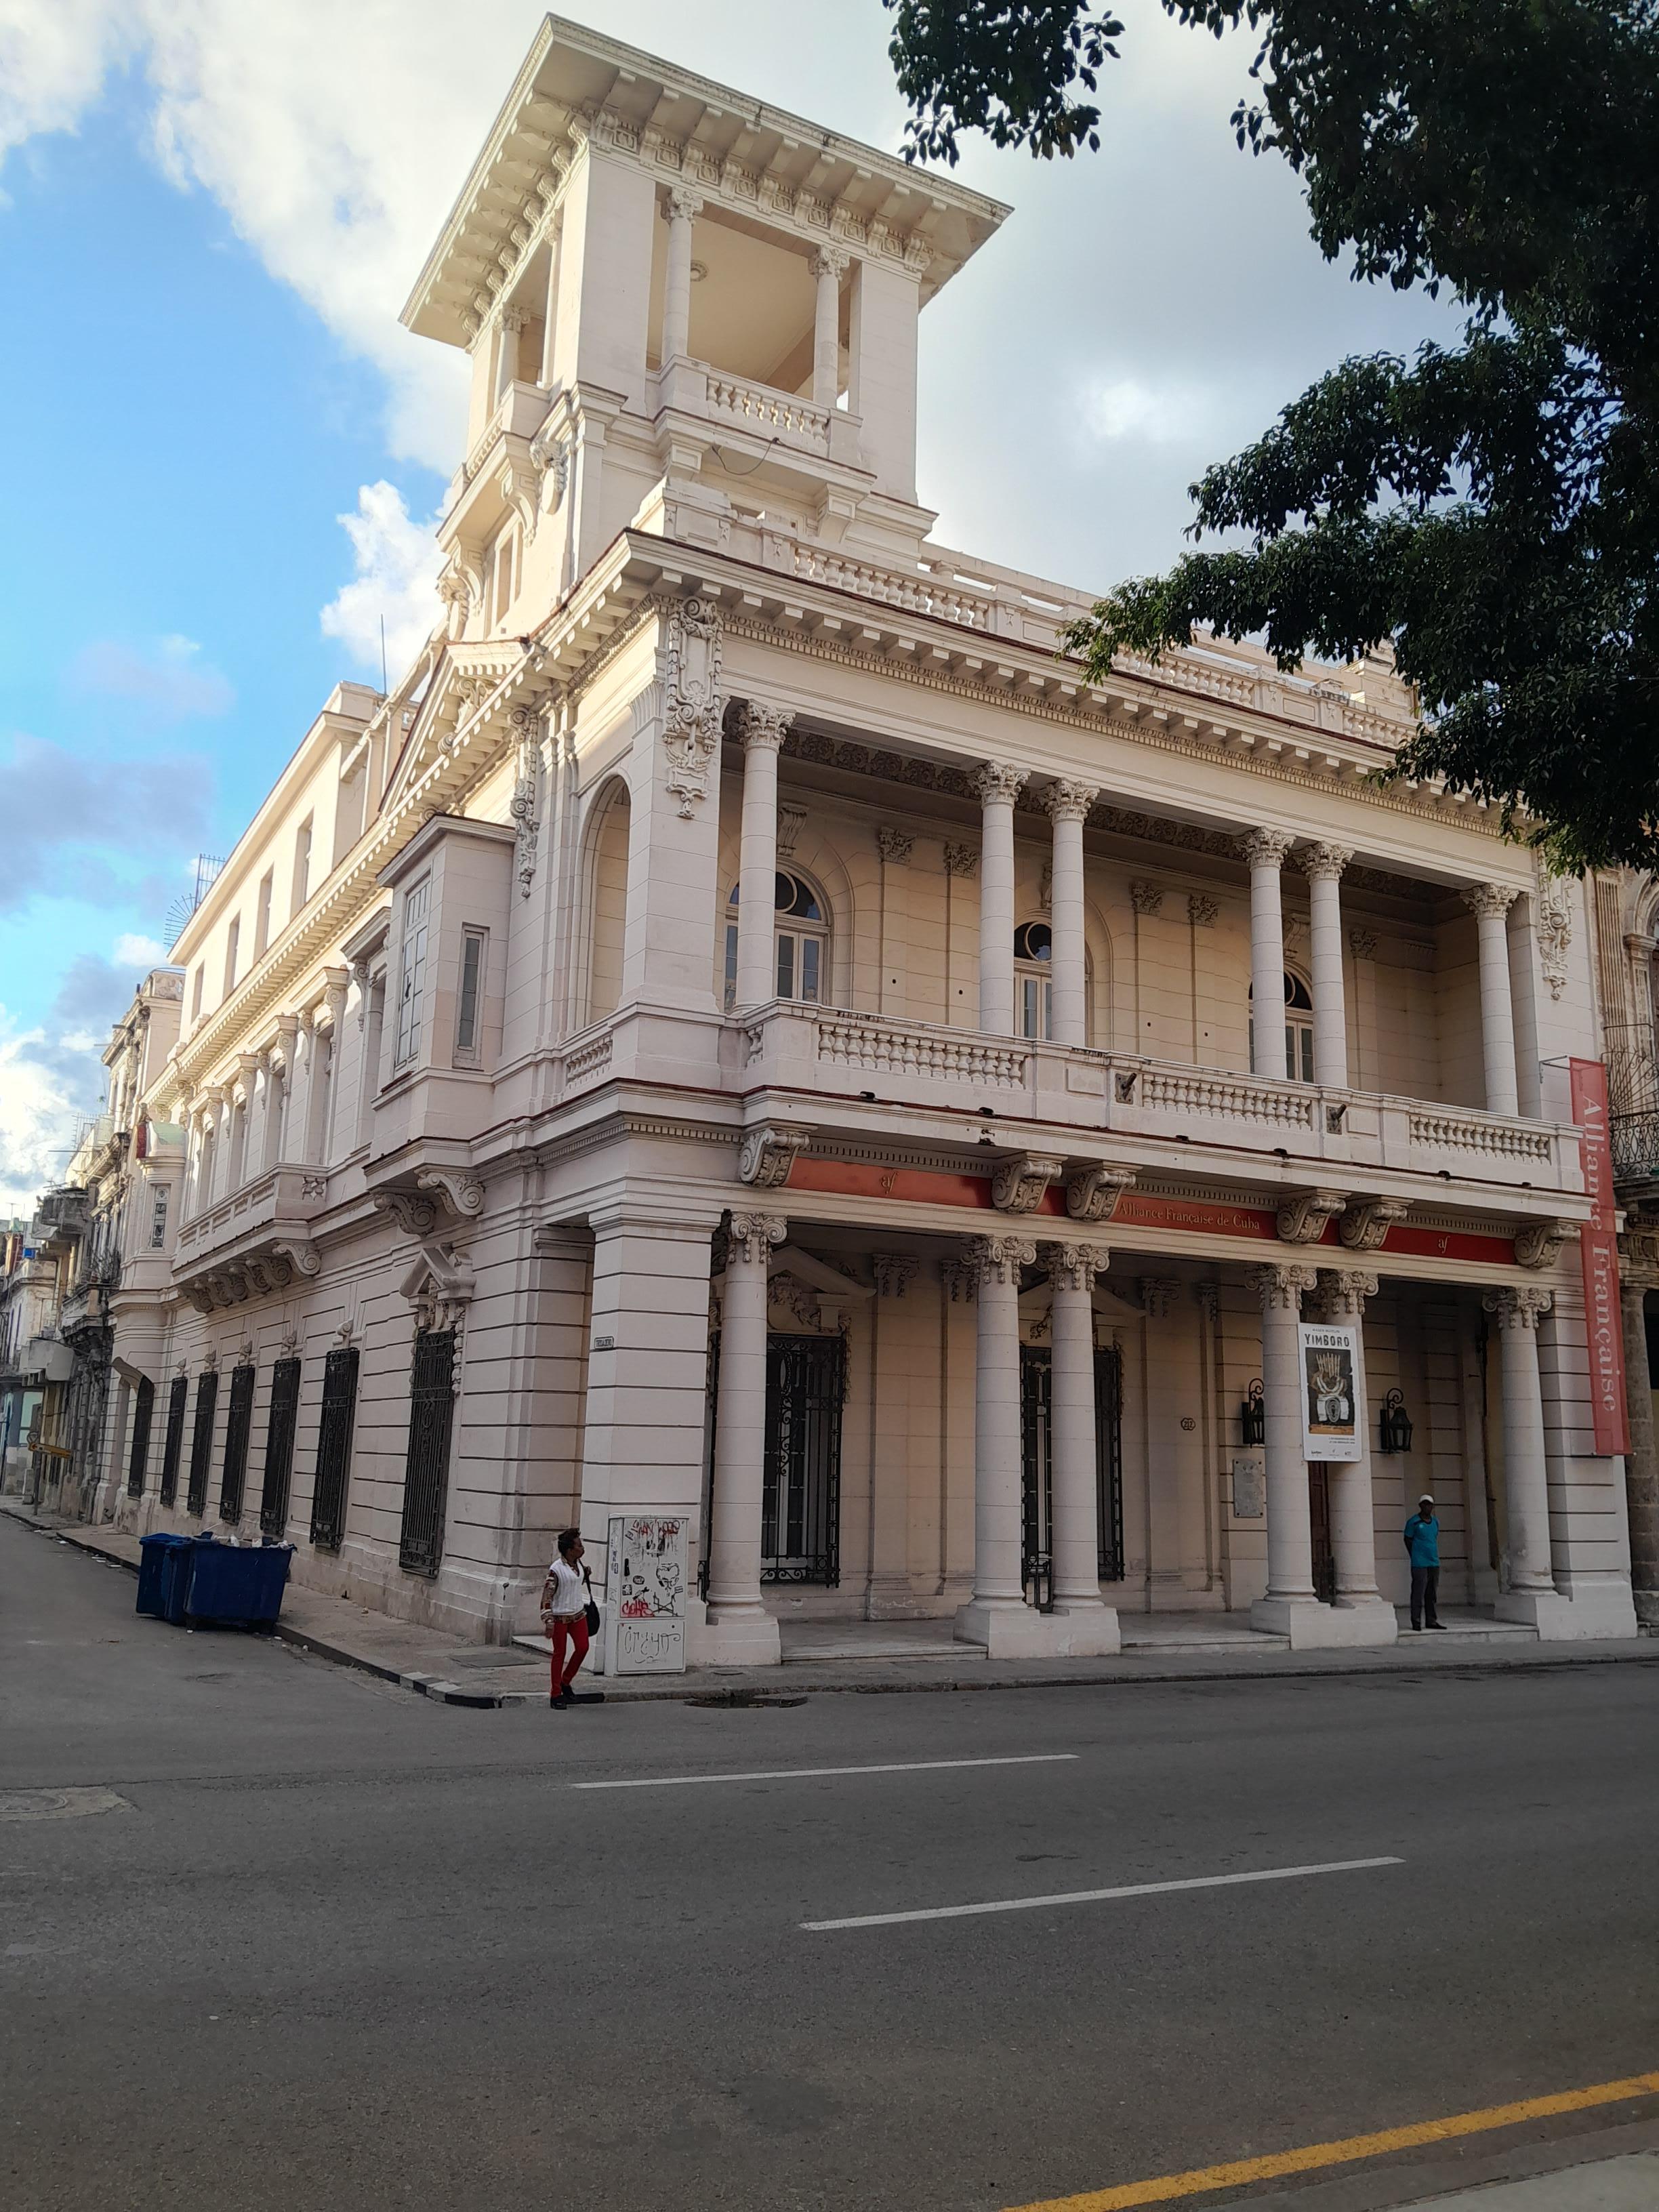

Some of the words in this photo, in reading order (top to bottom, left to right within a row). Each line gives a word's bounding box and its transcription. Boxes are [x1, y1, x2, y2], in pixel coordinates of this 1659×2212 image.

[1120, 1202, 1163, 1219] Alliance
[1165, 1206, 1212, 1225] Française
[1217, 1212, 1229, 1227] de
[1233, 1214, 1260, 1231] Cuba
[1593, 1243, 1621, 1411] Française
